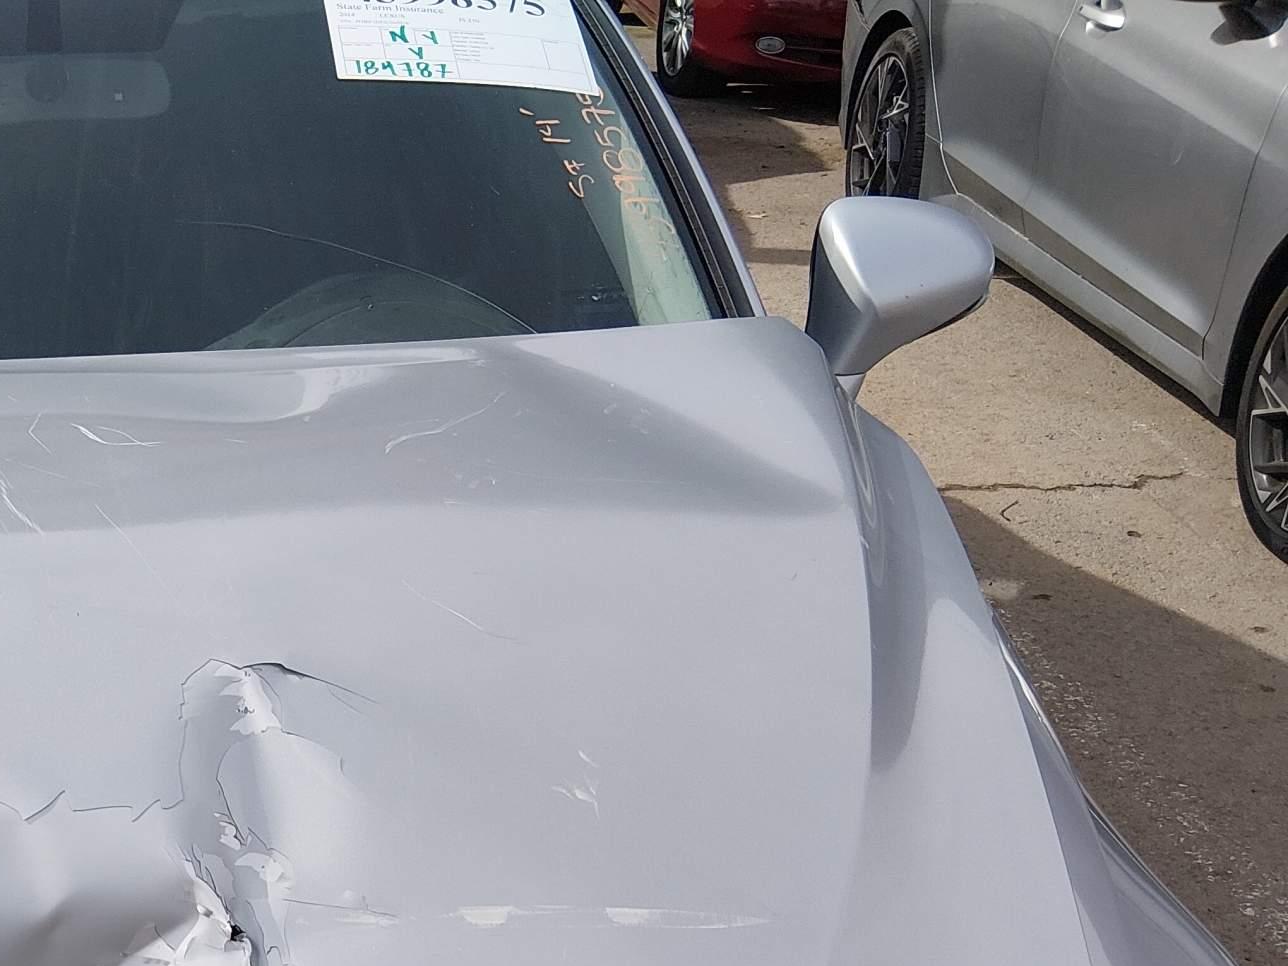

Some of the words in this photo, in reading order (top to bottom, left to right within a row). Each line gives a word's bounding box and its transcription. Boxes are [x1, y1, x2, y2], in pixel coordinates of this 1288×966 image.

[336, 3, 362, 11] State
[364, 3, 392, 12] Farm
[395, 5, 444, 14] Insurance
[575, 86, 676, 258] 998575
